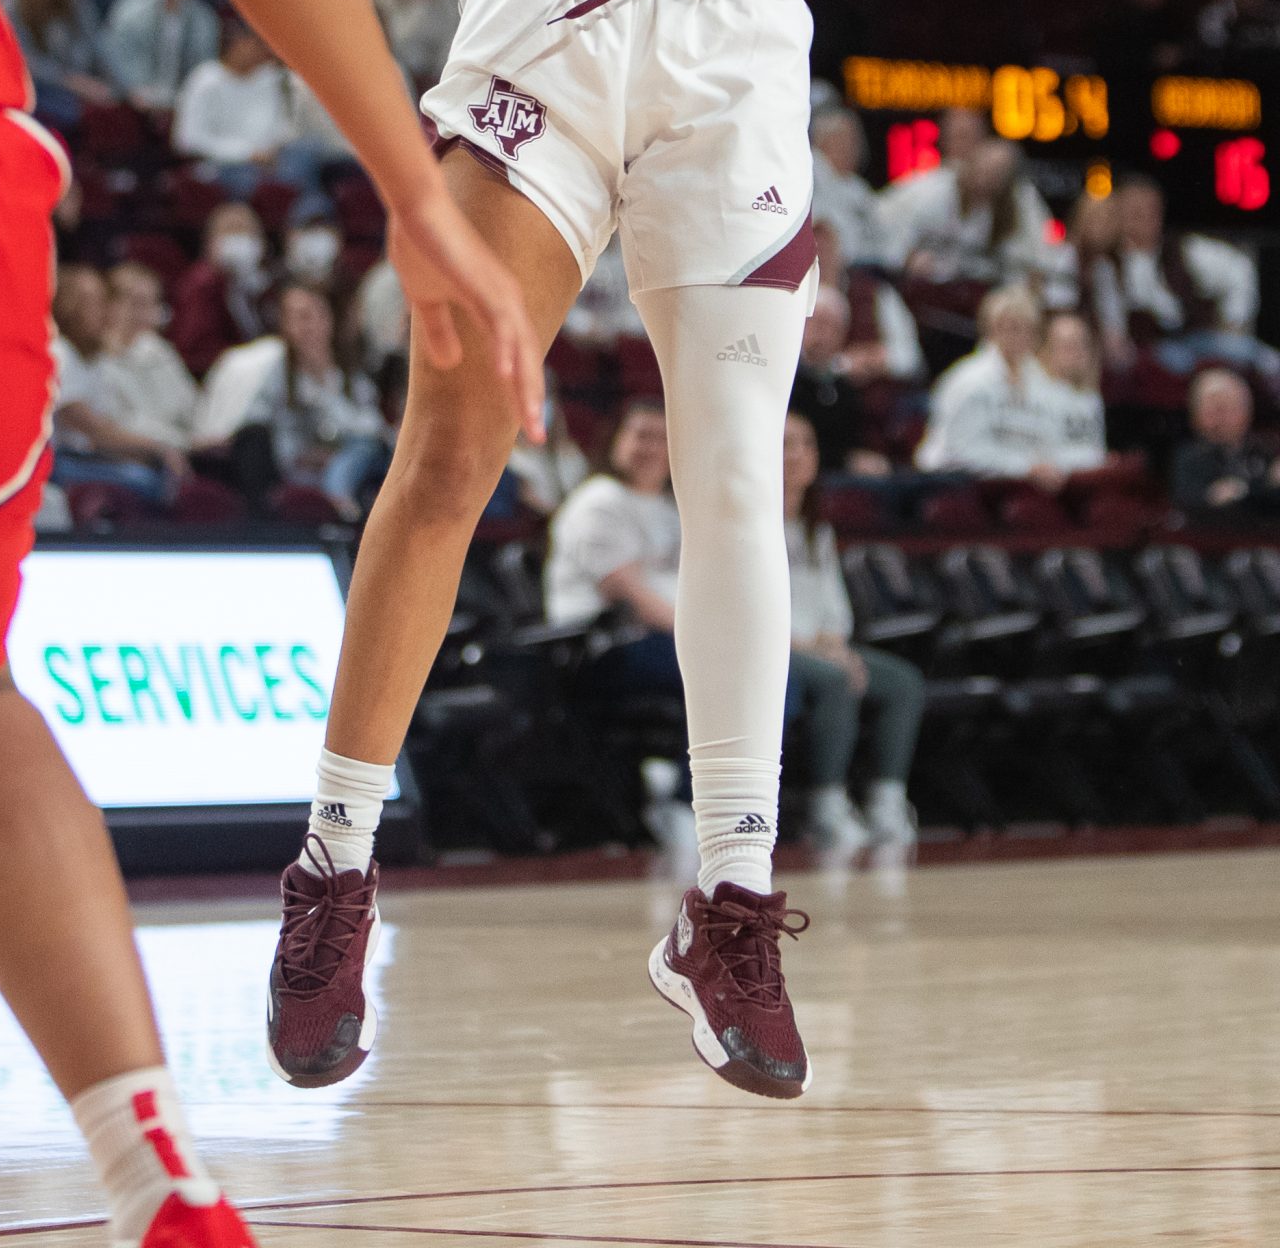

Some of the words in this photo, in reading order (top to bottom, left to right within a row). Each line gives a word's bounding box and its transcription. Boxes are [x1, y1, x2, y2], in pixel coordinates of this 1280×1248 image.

[751, 201, 788, 216] adidas
[716, 351, 768, 367] adidas
[43, 644, 329, 725] SERVICES
[317, 808, 352, 827] adidas
[734, 822, 771, 833] adidas
